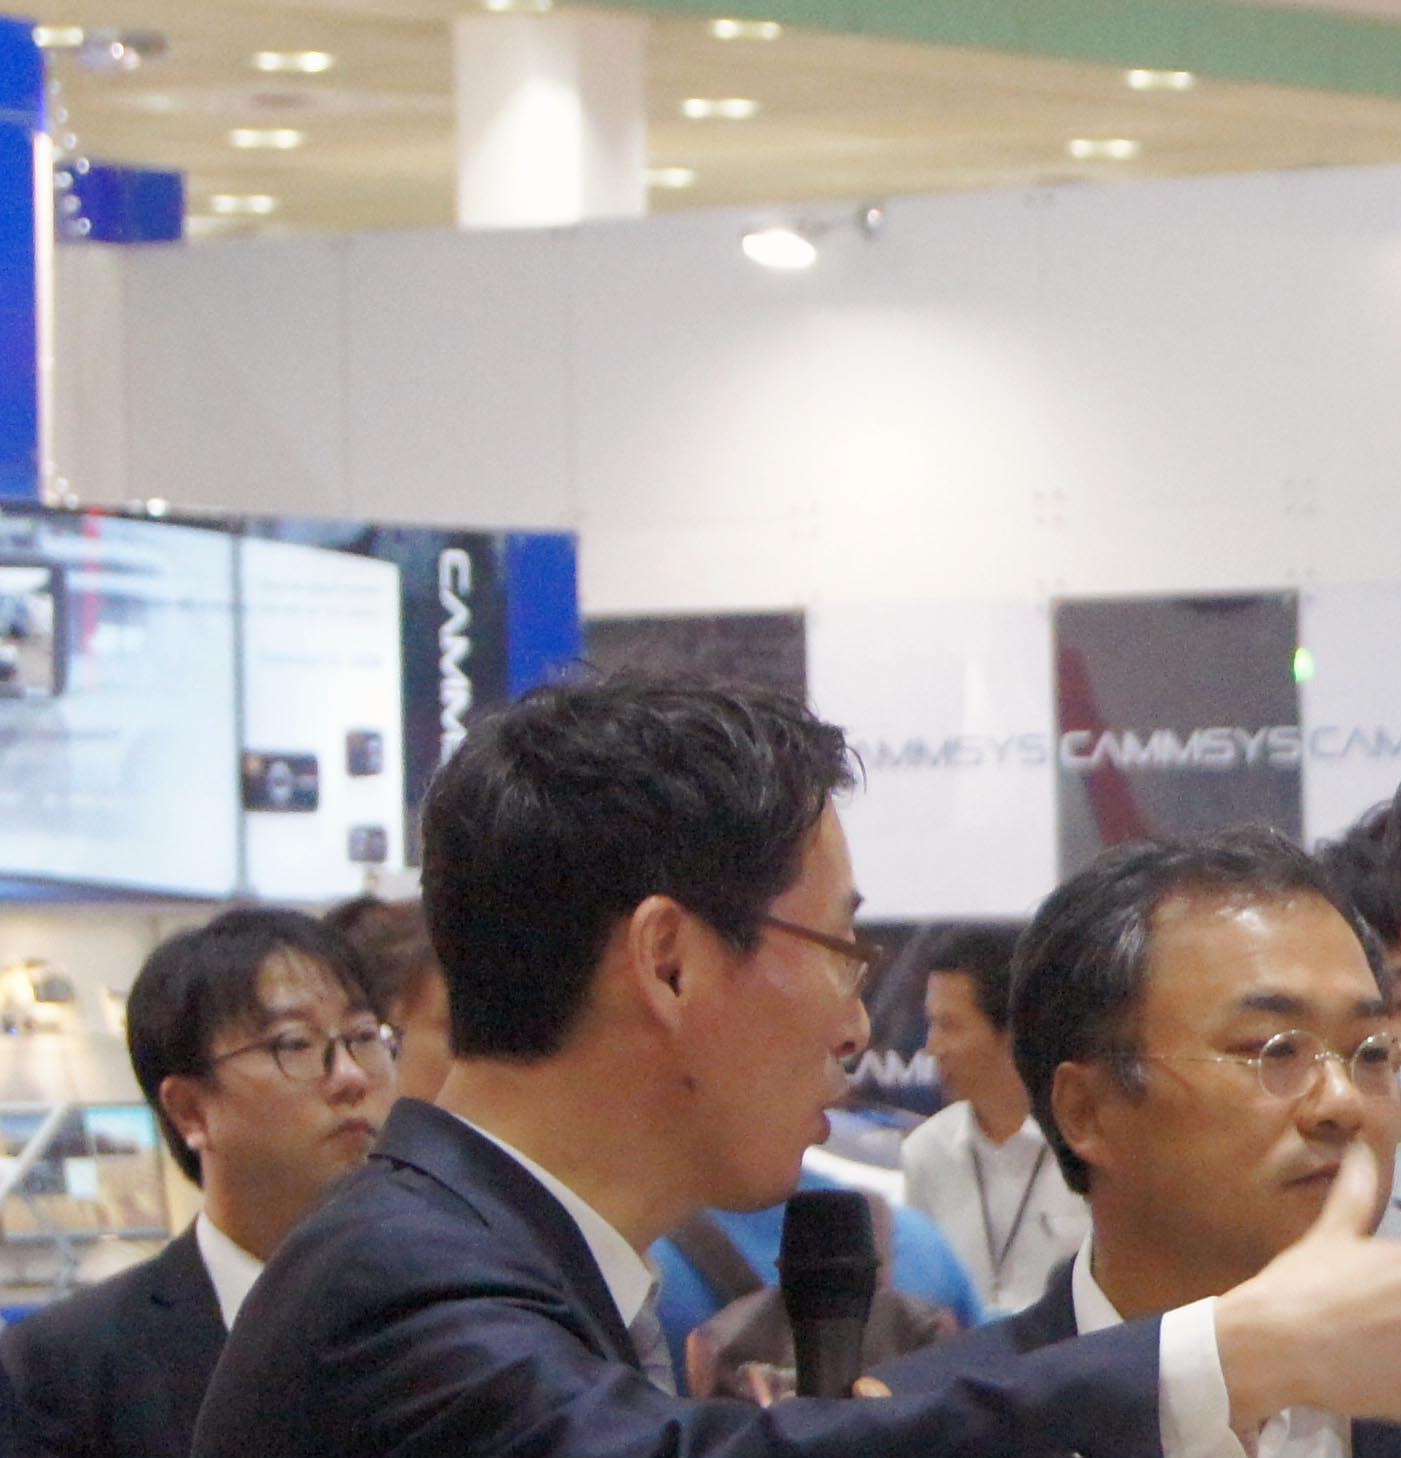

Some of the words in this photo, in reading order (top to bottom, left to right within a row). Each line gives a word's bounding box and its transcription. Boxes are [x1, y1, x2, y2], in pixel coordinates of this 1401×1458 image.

[437, 547, 473, 766] CAMM
[856, 731, 1048, 771] AMMSYS
[1059, 725, 1302, 771] CAMMSYS
